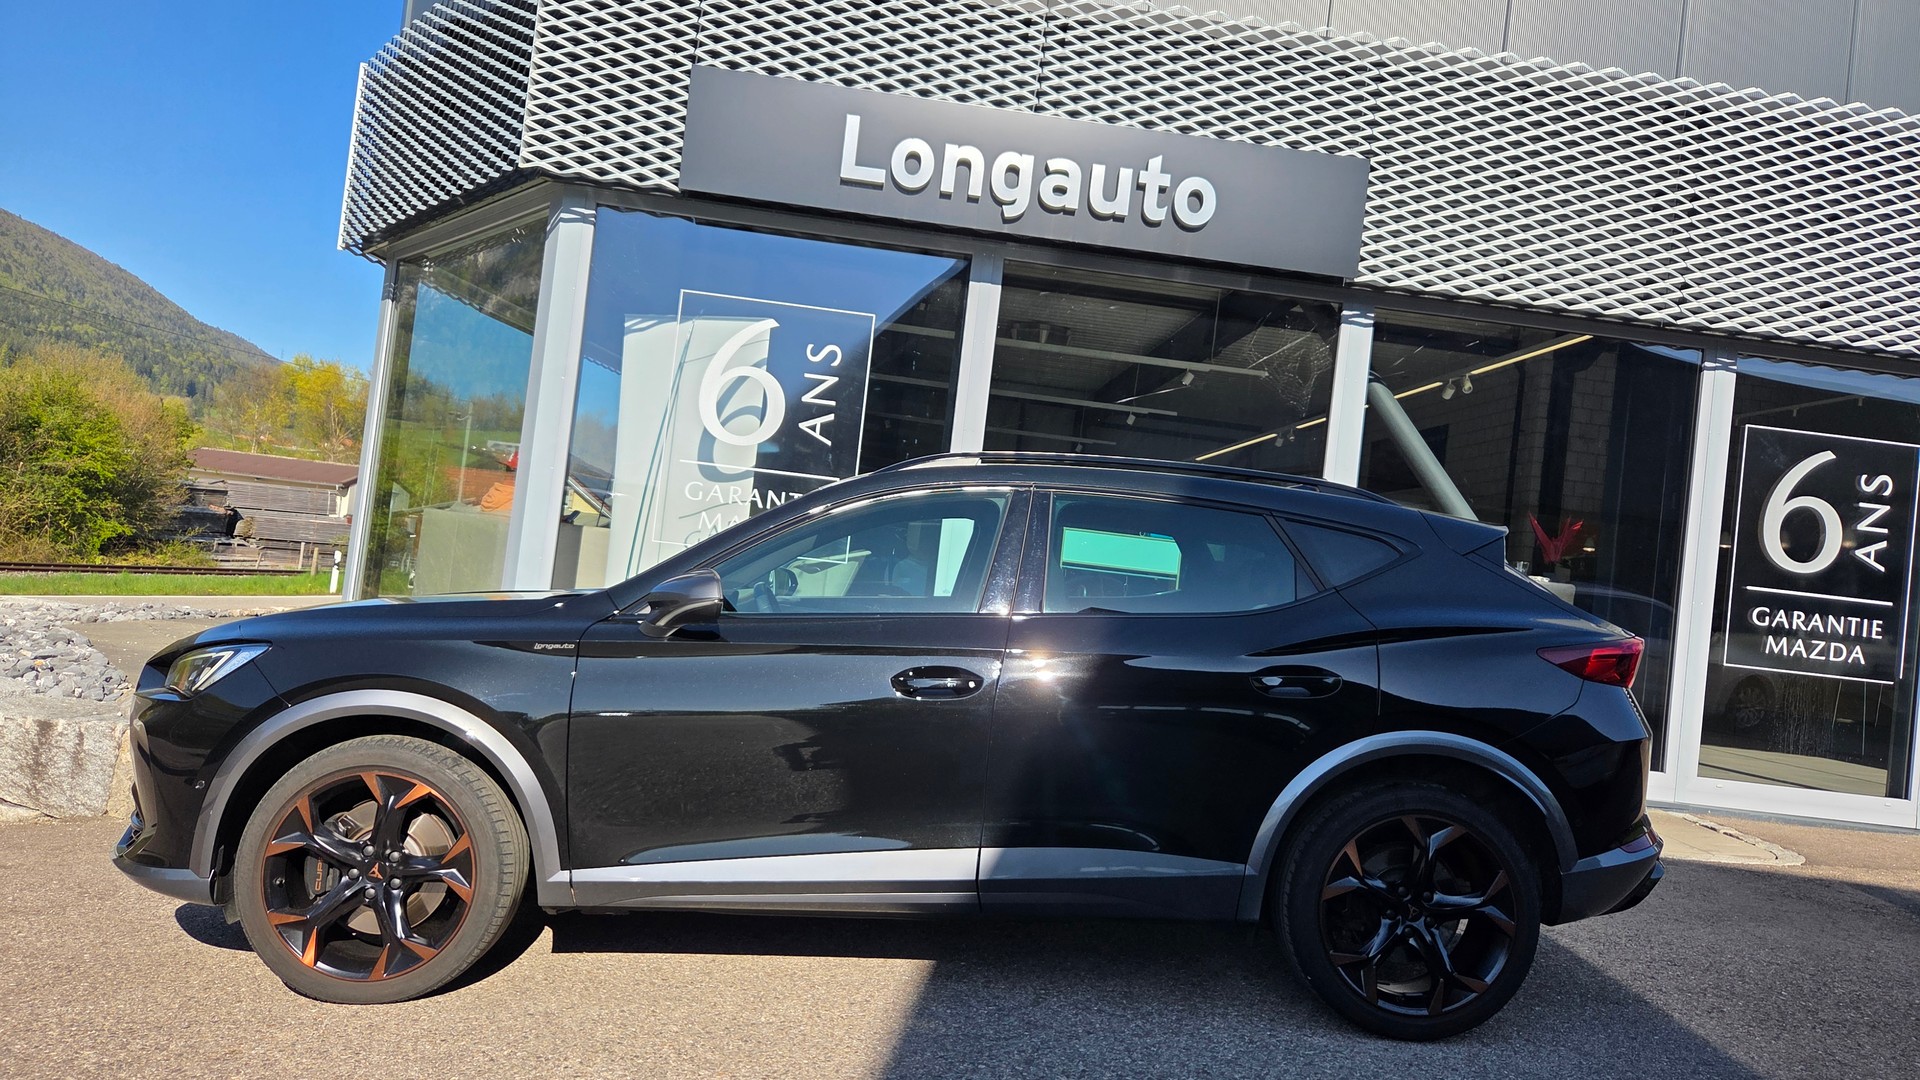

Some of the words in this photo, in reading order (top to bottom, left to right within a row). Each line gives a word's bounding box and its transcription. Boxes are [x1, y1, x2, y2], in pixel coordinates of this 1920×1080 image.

[840, 113, 1217, 228] Longauto
[699, 318, 785, 445] 6
[798, 343, 842, 446] ANS
[1763, 450, 1843, 573] 6
[1855, 473, 1893, 573] ANS
[1751, 606, 1883, 639] GARANTIE
[1765, 636, 1866, 665] MAZDA
